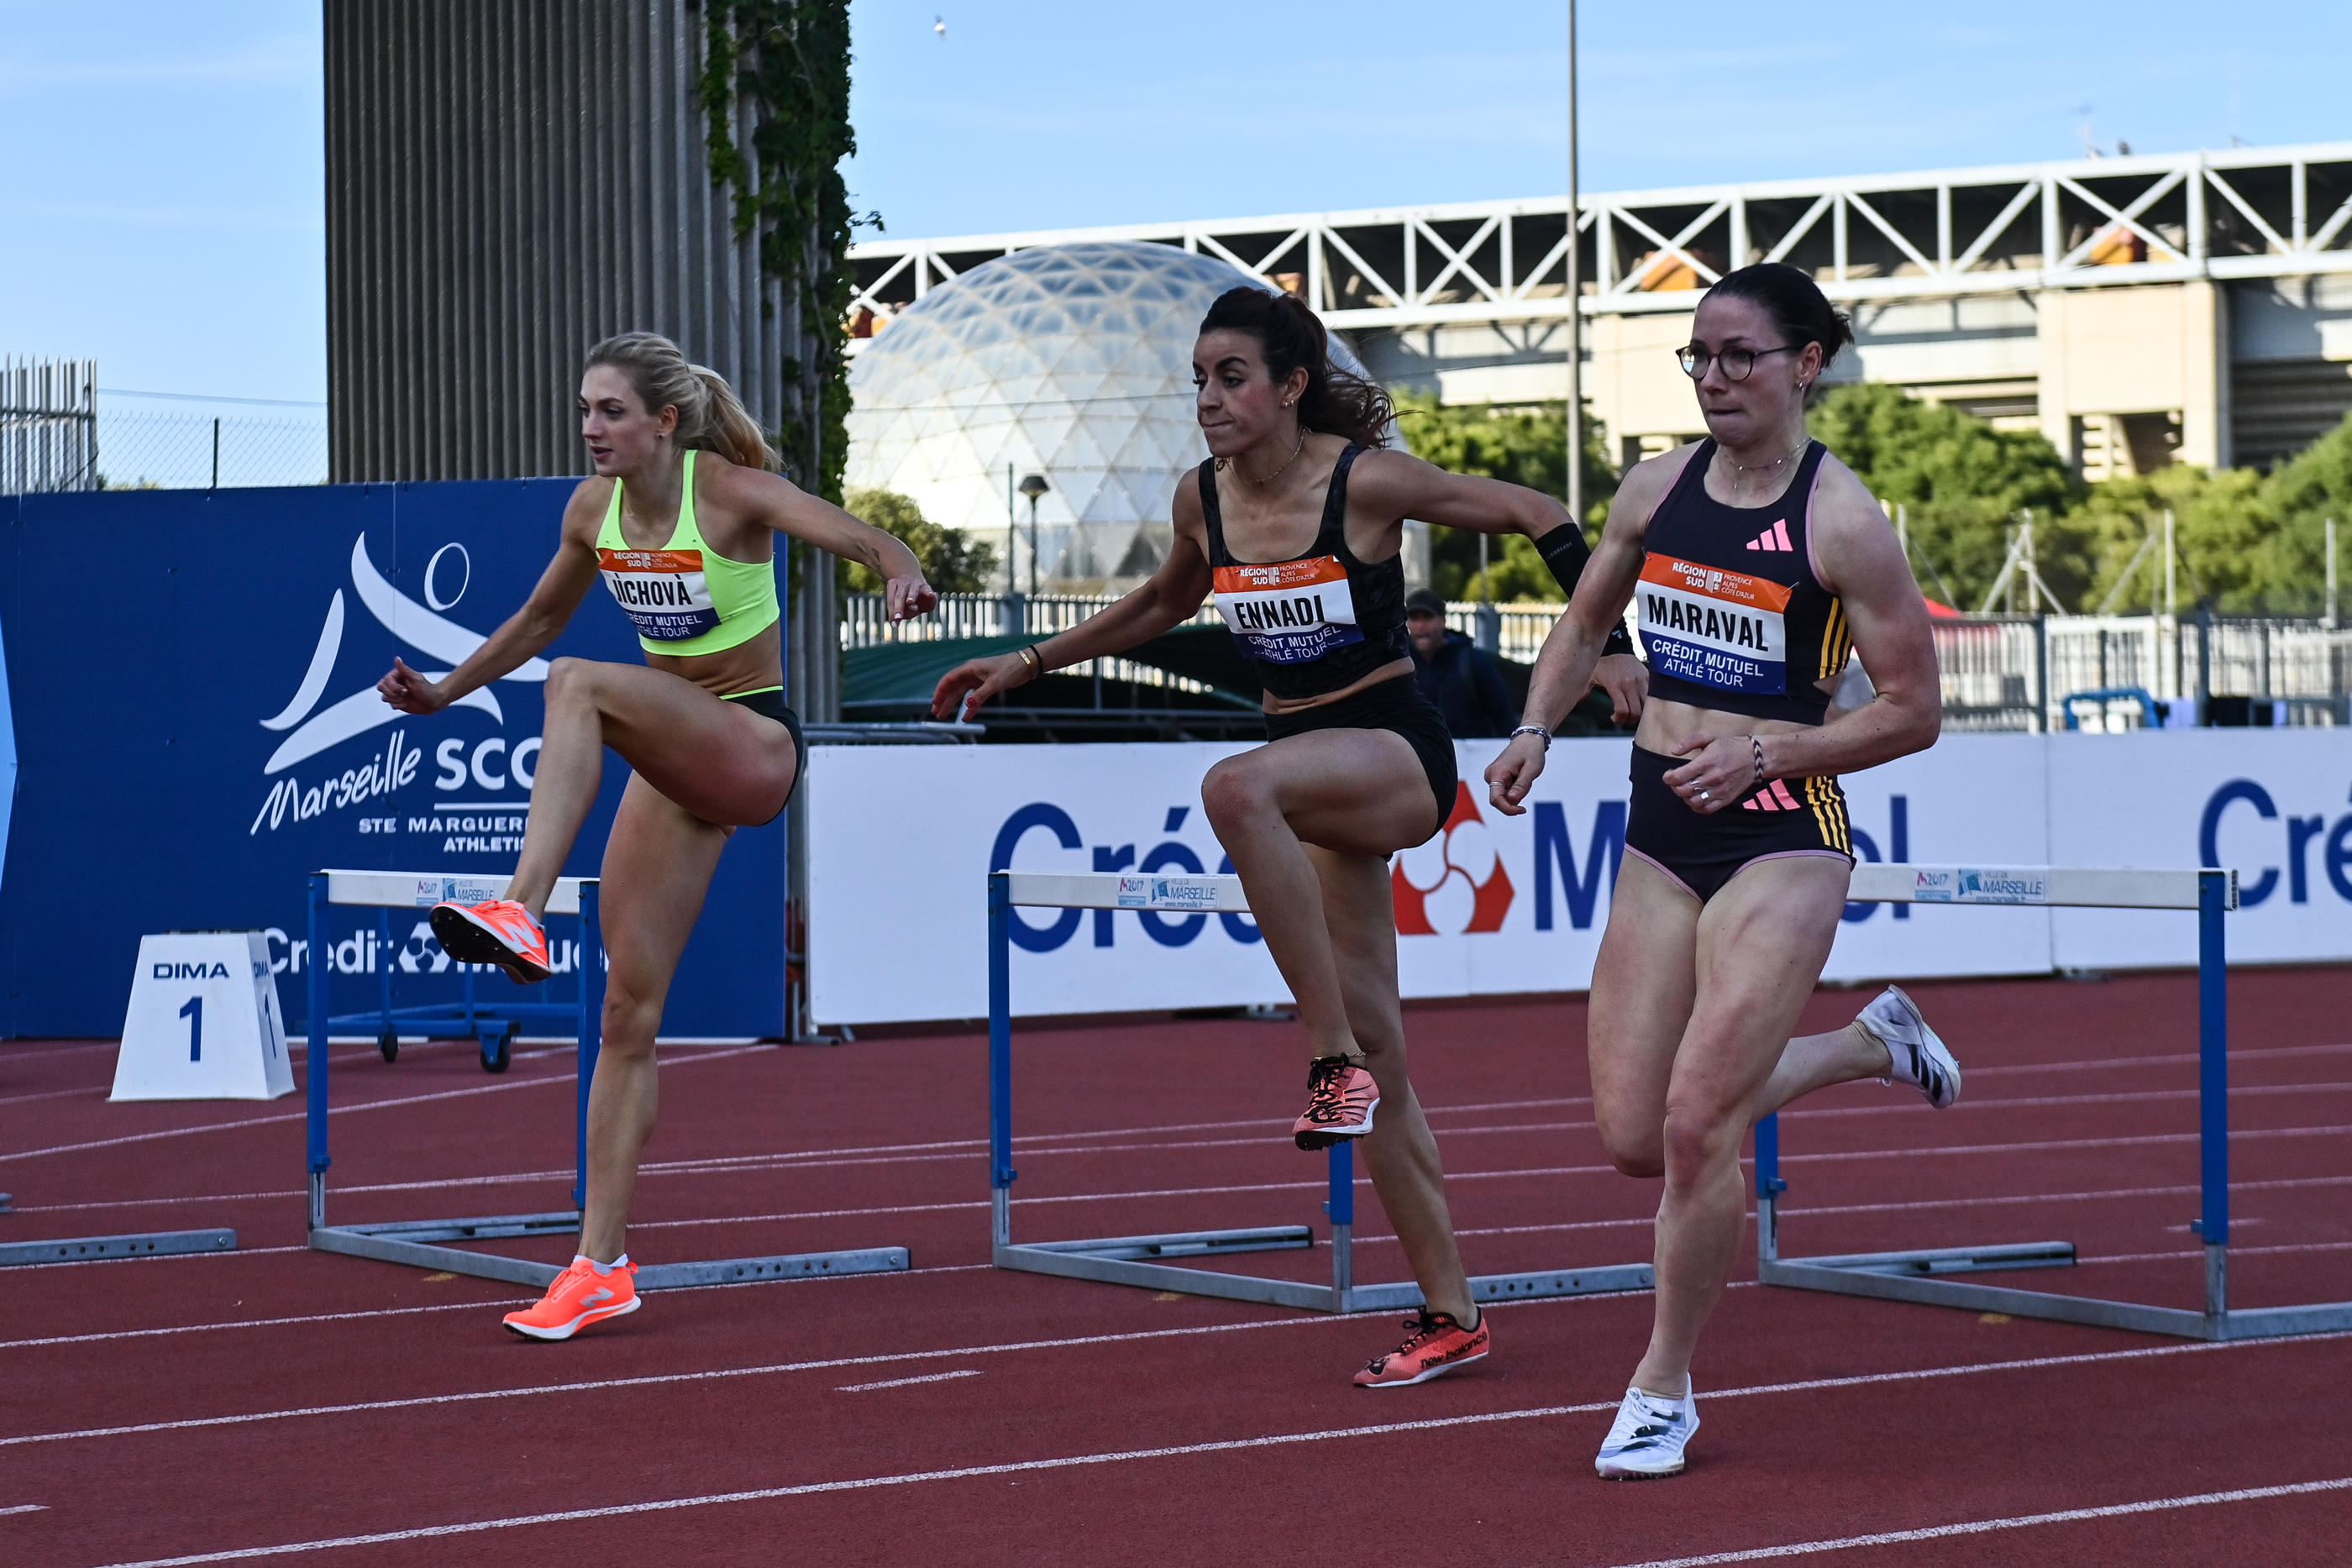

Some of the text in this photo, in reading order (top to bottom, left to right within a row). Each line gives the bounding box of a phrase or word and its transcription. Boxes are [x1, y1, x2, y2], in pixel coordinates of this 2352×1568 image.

[613, 551, 640, 559] RÉGION
[1240, 568, 1268, 577] RÉGION
[1279, 563, 1308, 571] PROVENCE
[1672, 562, 1707, 578] RÉGION
[1252, 576, 1268, 585] SUD
[1686, 576, 1704, 588] SUD
[1724, 574, 1753, 585] PROVENCE
[1234, 595, 1325, 629] ENNADI
[655, 615, 702, 627] MUTUEL
[1647, 594, 1768, 652] MARAVAL
[660, 627, 690, 637] TOUR
[1248, 626, 1341, 649] CRÉDIT MUTUEL
[1264, 641, 1327, 661] ATHLÉ TOUR
[1652, 640, 1764, 676] CRÉDIT MUTUEL
[1664, 658, 1743, 687] ATHLÉ TOUR
[250, 729, 421, 836] Marseille
[359, 818, 396, 833] STE
[1170, 886, 1215, 900] MARSEILLE
[1983, 879, 2043, 894] MARSEILLE
[456, 889, 494, 901] MARSEILLE
[153, 962, 229, 979] DIMA
[254, 961, 269, 978] DIMA
[179, 995, 202, 1062] 1
[265, 993, 276, 1059] 1
[1421, 1331, 1488, 1369] new balance
